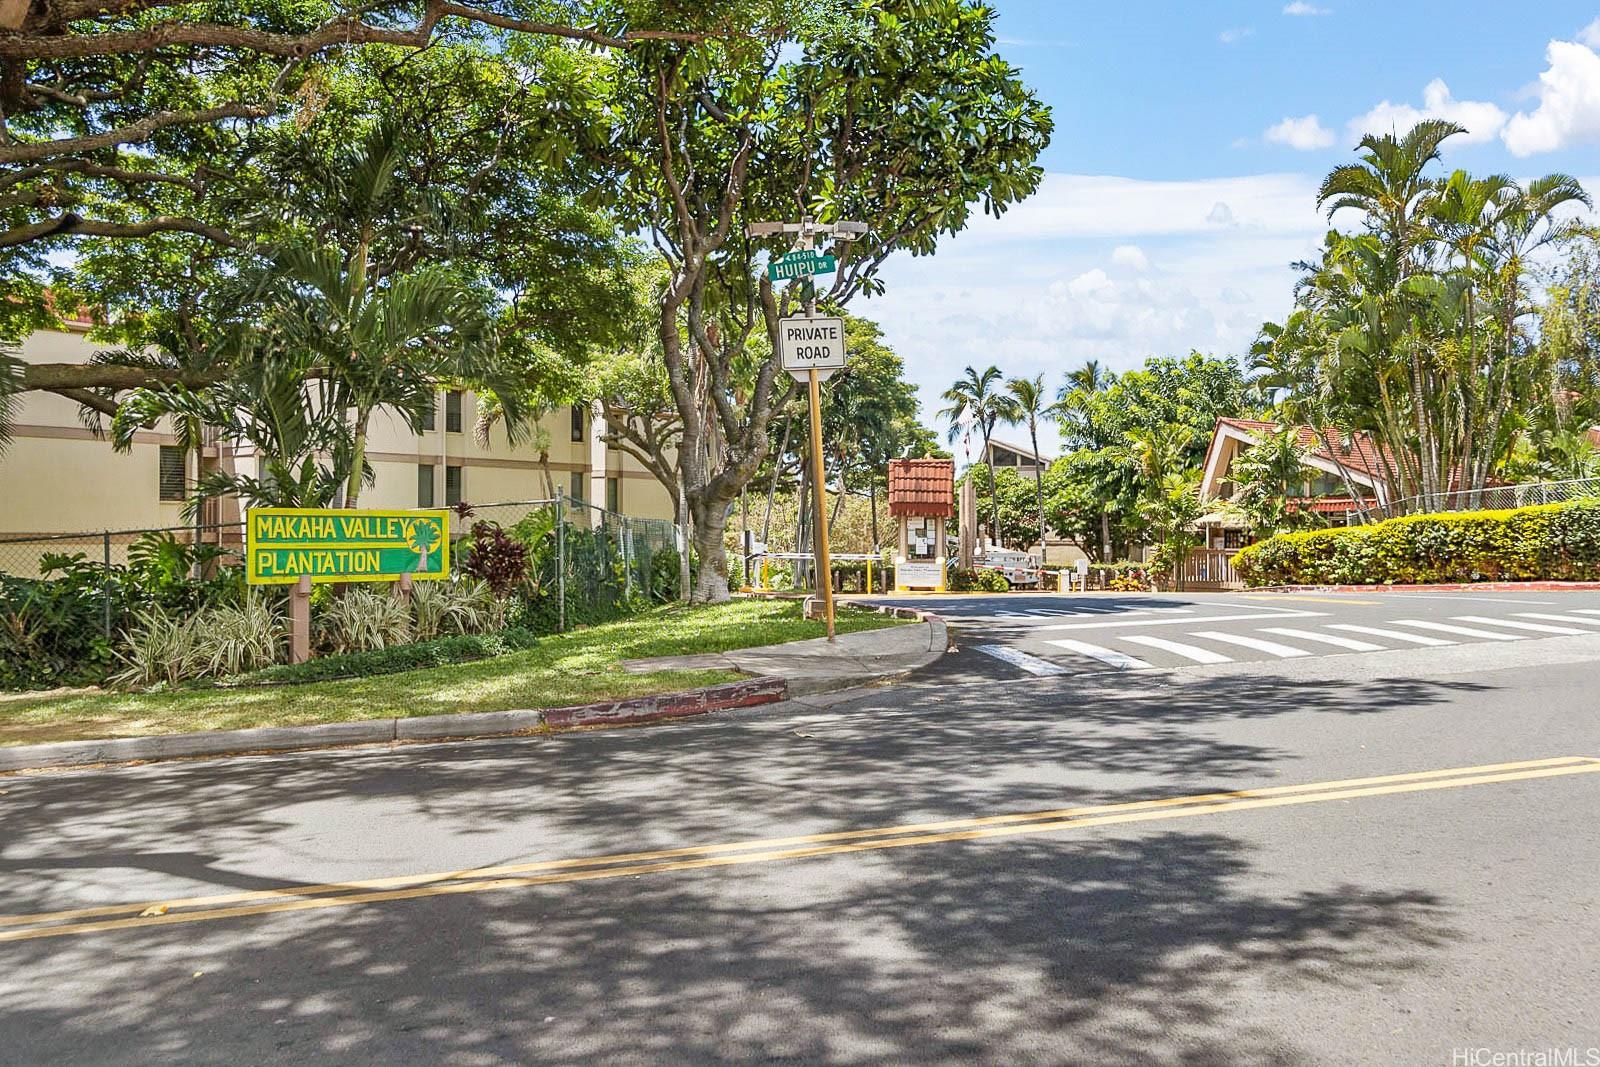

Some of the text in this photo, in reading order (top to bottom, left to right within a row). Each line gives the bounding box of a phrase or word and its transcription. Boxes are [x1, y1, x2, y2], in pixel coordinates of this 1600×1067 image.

[775, 261, 828, 278] HUIPU DR
[787, 327, 837, 340] PRIVATE
[797, 346, 830, 360] ROAD
[257, 516, 409, 539] MAKAHA VALLEY
[258, 550, 381, 574] PLANTATION
